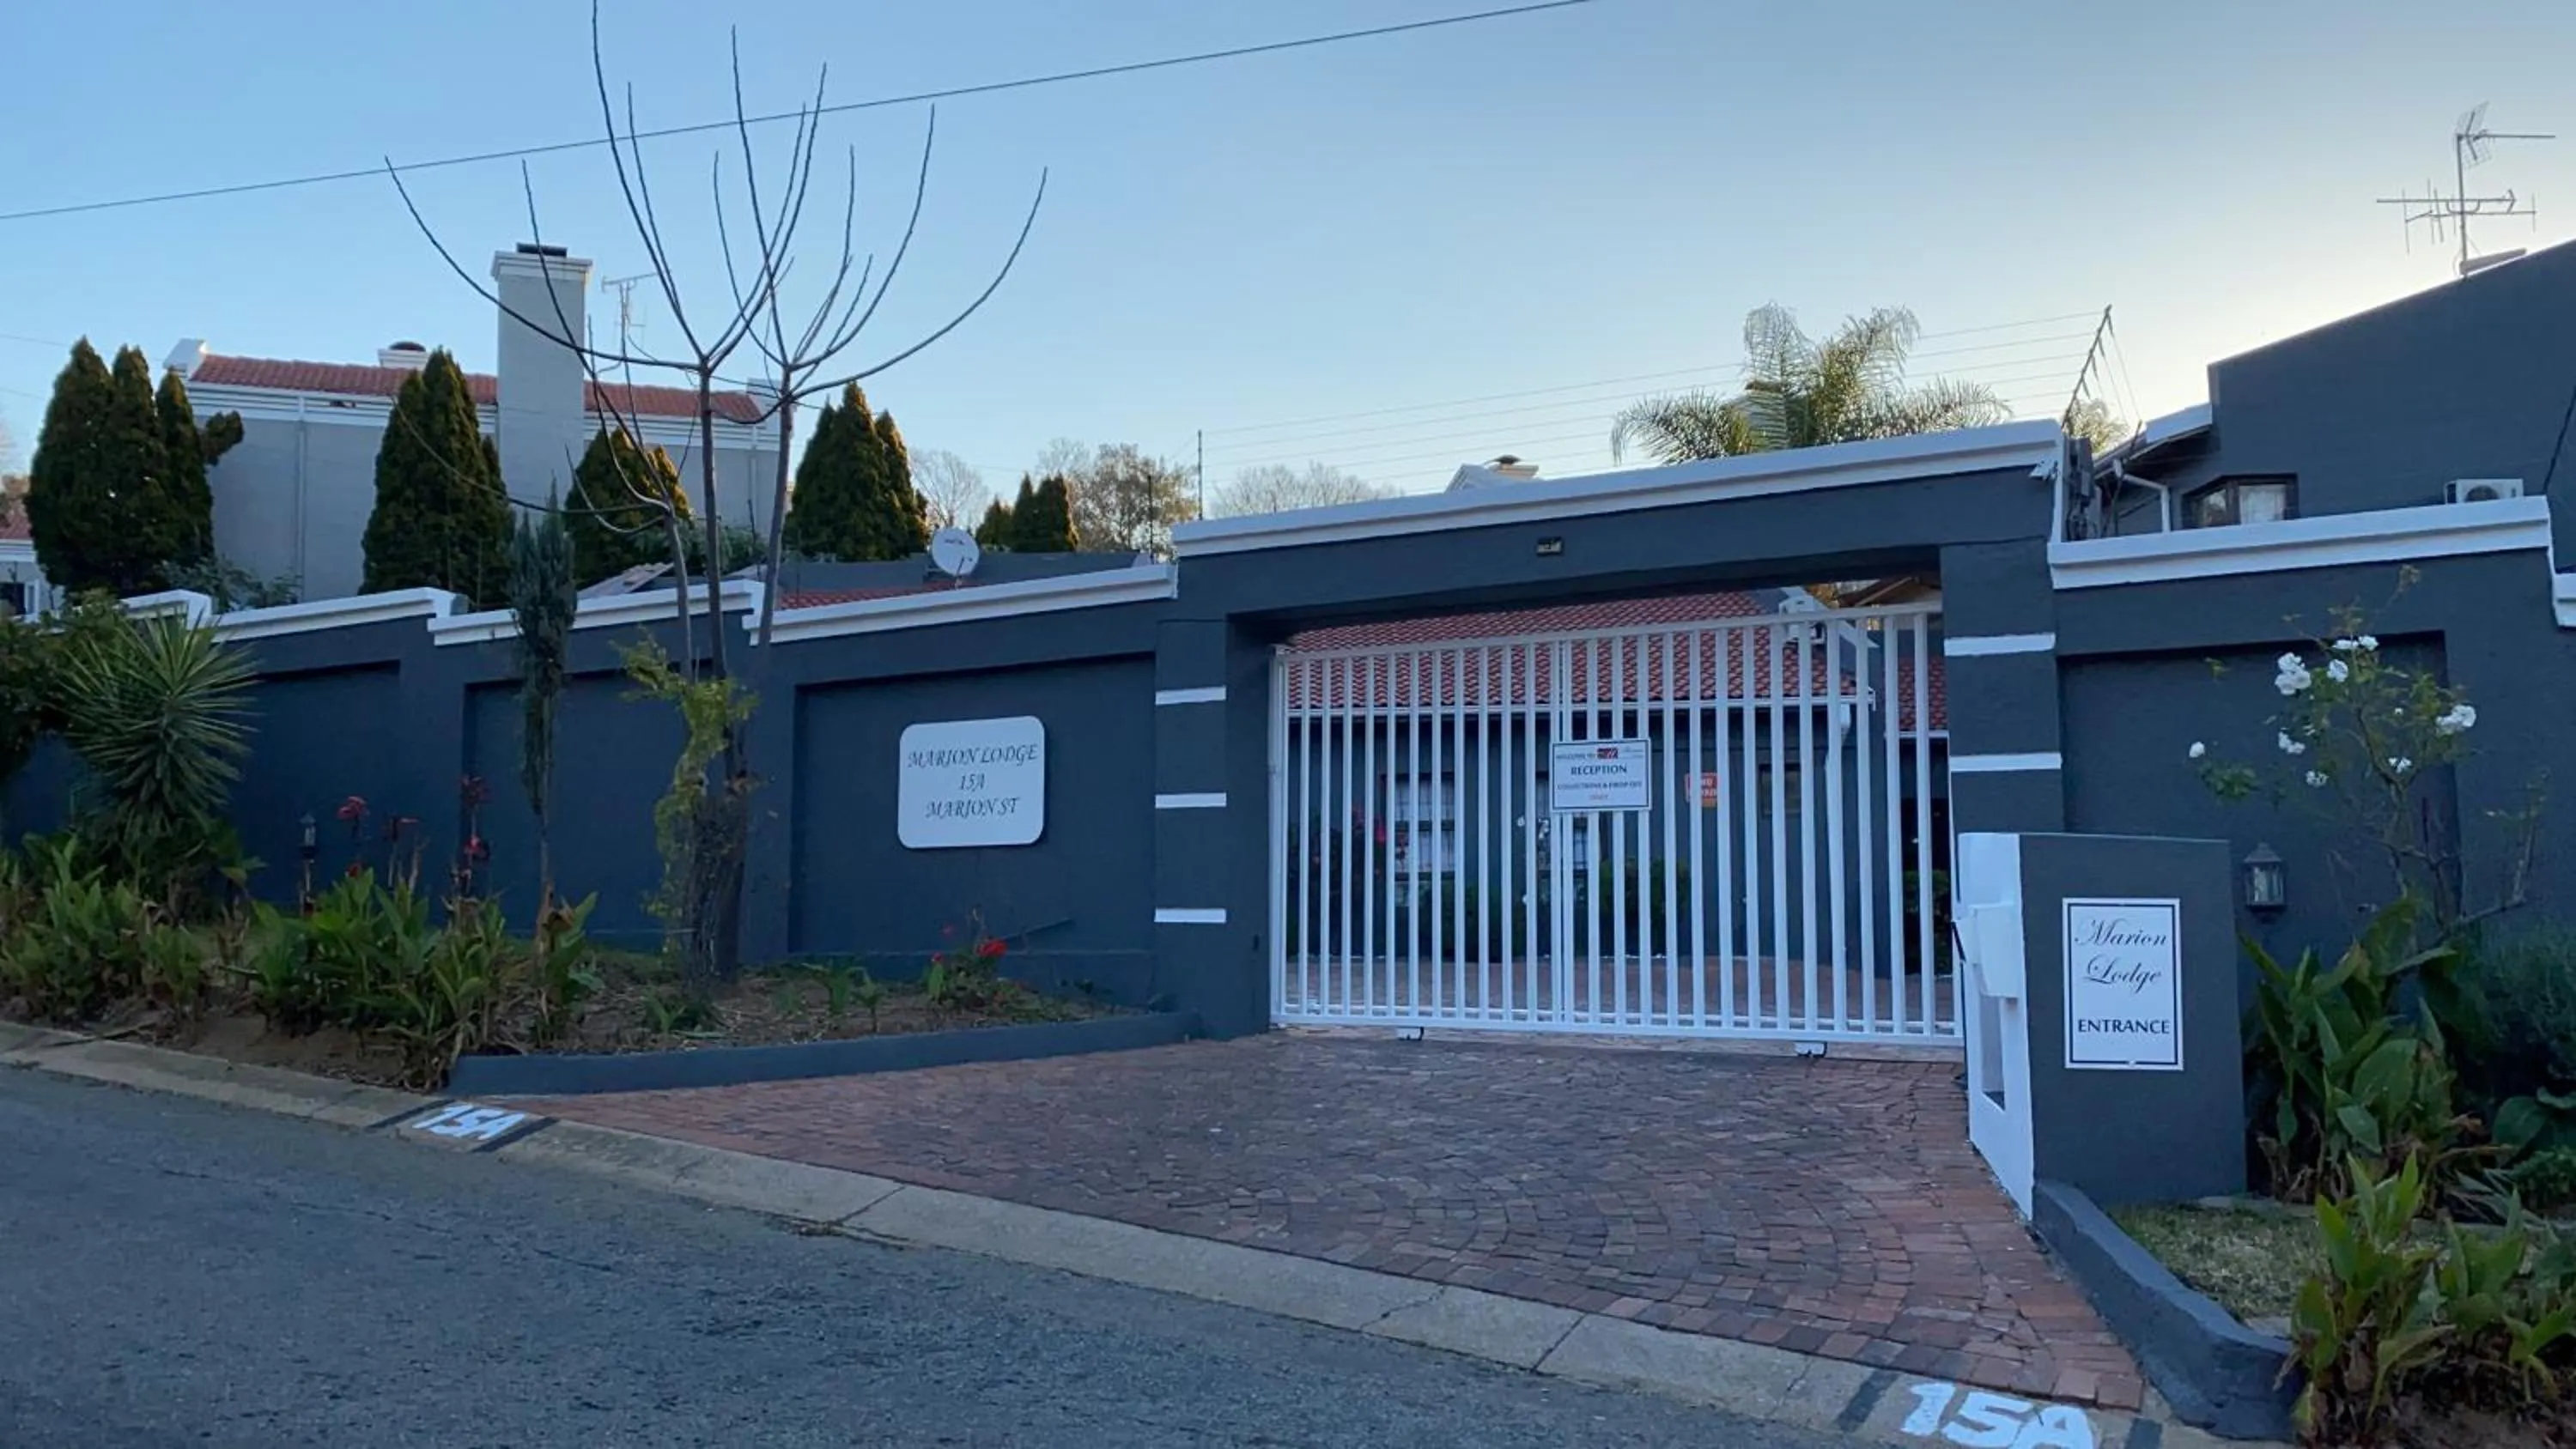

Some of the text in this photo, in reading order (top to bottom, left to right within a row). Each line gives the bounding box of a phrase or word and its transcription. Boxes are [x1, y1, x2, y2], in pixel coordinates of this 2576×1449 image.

[908, 744, 1038, 768] MARION LODGE
[1571, 763, 1627, 776] RECEPTION
[960, 773, 986, 791] 15A
[925, 797, 1020, 818] MARION ST
[2075, 918, 2167, 945] Marion
[2083, 954, 2162, 994] Lodge
[2078, 1018, 2170, 1034] ENTRANCE
[412, 1103, 526, 1140] 15A
[1900, 1382, 2094, 1449] 15A
